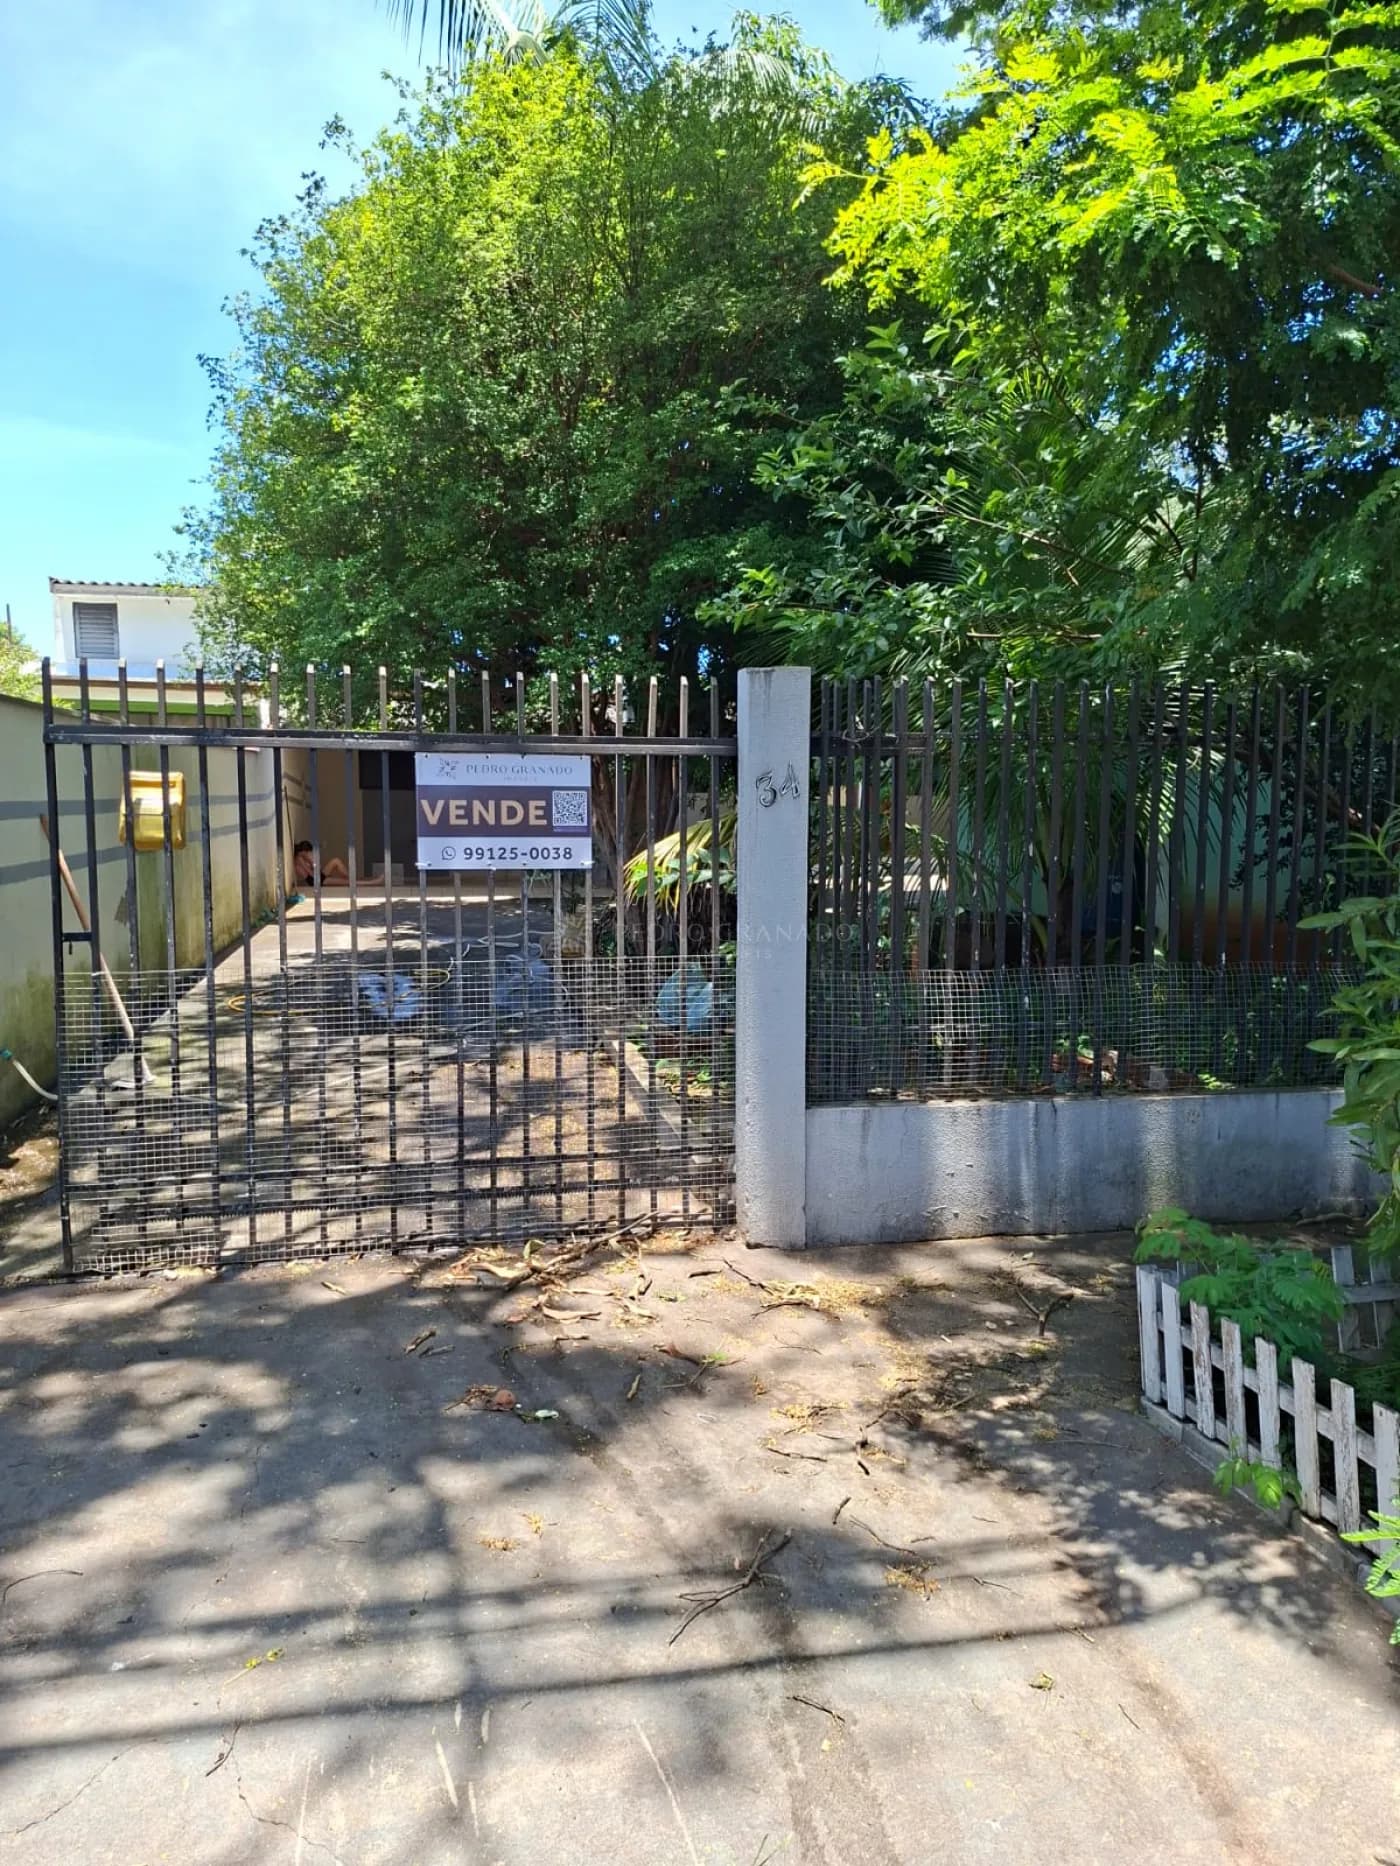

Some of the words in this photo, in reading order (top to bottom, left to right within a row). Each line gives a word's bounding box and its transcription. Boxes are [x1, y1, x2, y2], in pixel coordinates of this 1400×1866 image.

[466, 764, 508, 774] PEDRO
[511, 765, 573, 775] GRANADO
[755, 758, 800, 808] 34
[420, 799, 547, 826] VENDE
[463, 846, 573, 861] 99125-0038
